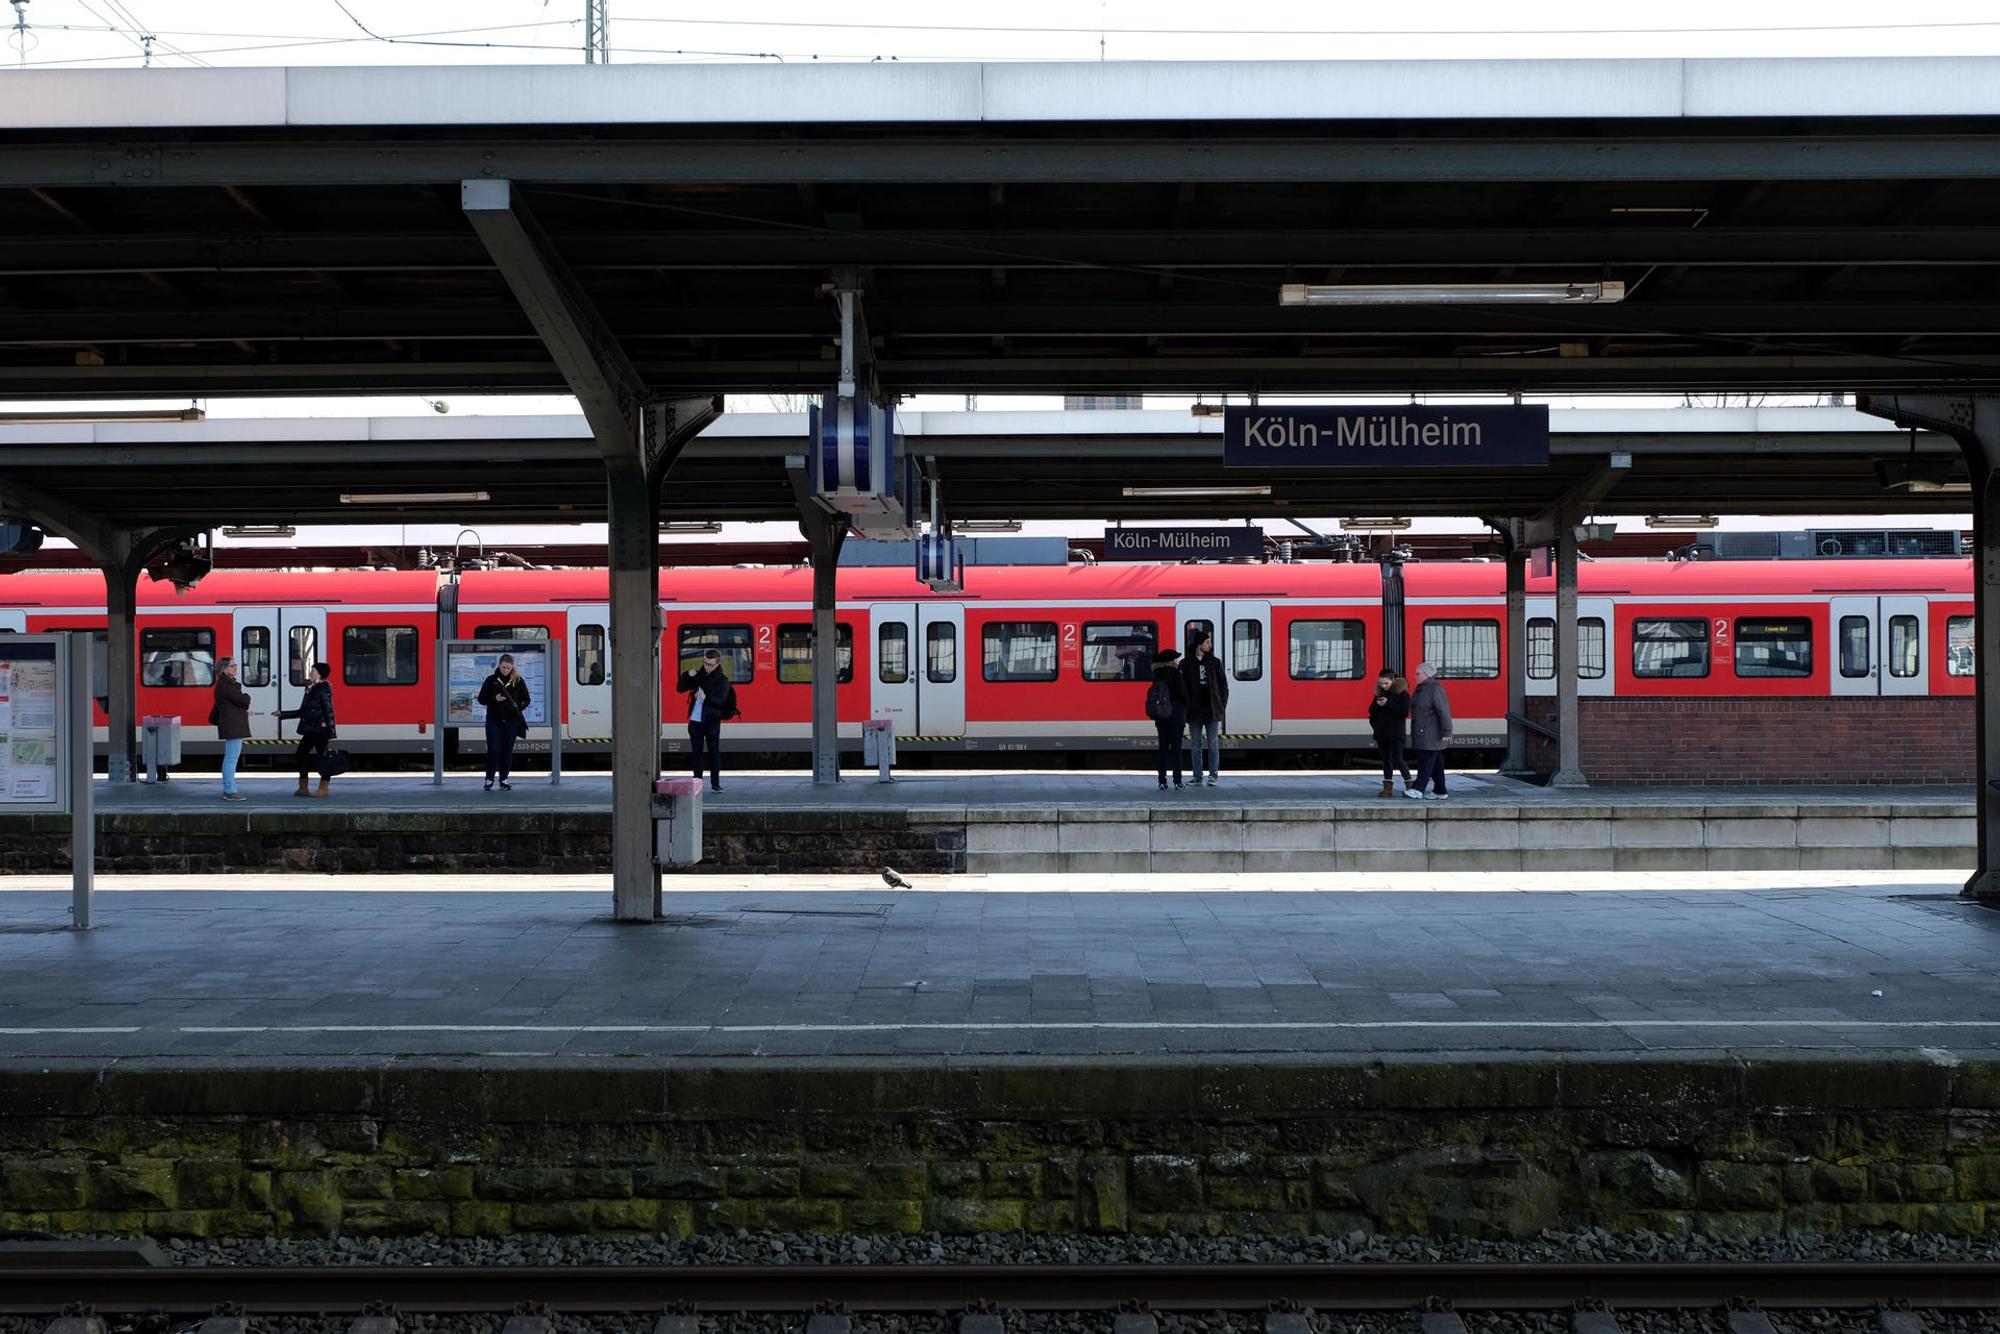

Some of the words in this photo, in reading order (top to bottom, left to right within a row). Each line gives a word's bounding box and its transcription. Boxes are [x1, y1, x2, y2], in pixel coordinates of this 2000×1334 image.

[1244, 416, 1482, 447] Köln-Mülheim
[1114, 532, 1230, 548] Köln-Mülheim
[759, 626, 771, 644] 2
[1064, 624, 1075, 641] 2
[1715, 620, 1728, 637] 2
